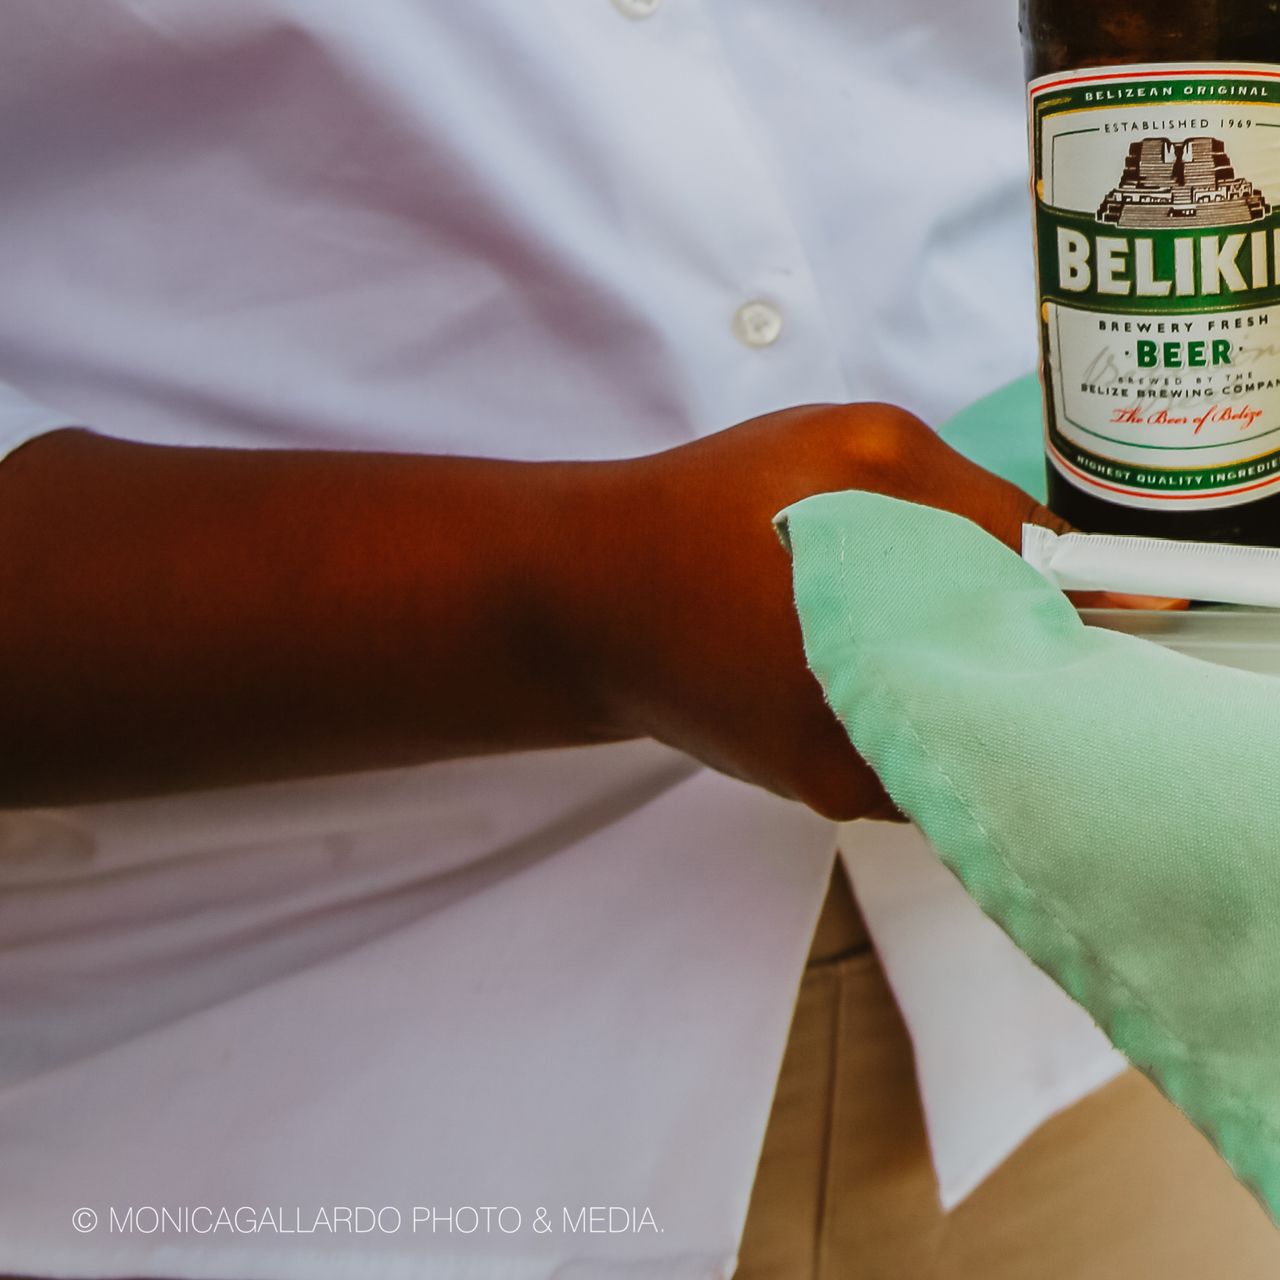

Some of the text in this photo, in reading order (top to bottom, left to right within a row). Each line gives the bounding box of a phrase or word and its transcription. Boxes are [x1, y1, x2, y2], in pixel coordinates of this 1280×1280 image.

[1085, 85, 1269, 102] BELIZEAN ORIGINAL
[1104, 118, 1252, 134] ESTABLISHED 1969
[1098, 314, 1269, 334] BREWERY FRESH
[1136, 339, 1233, 369] BEER
[1118, 371, 1254, 386] BREWED BY THE
[1080, 384, 1129, 398] BELIZE
[1137, 386, 1214, 399] BREWING
[1109, 403, 1265, 435] The Beer of Belize
[1076, 454, 1131, 482] HIGHEST
[1137, 474, 1204, 486] QUALITY
